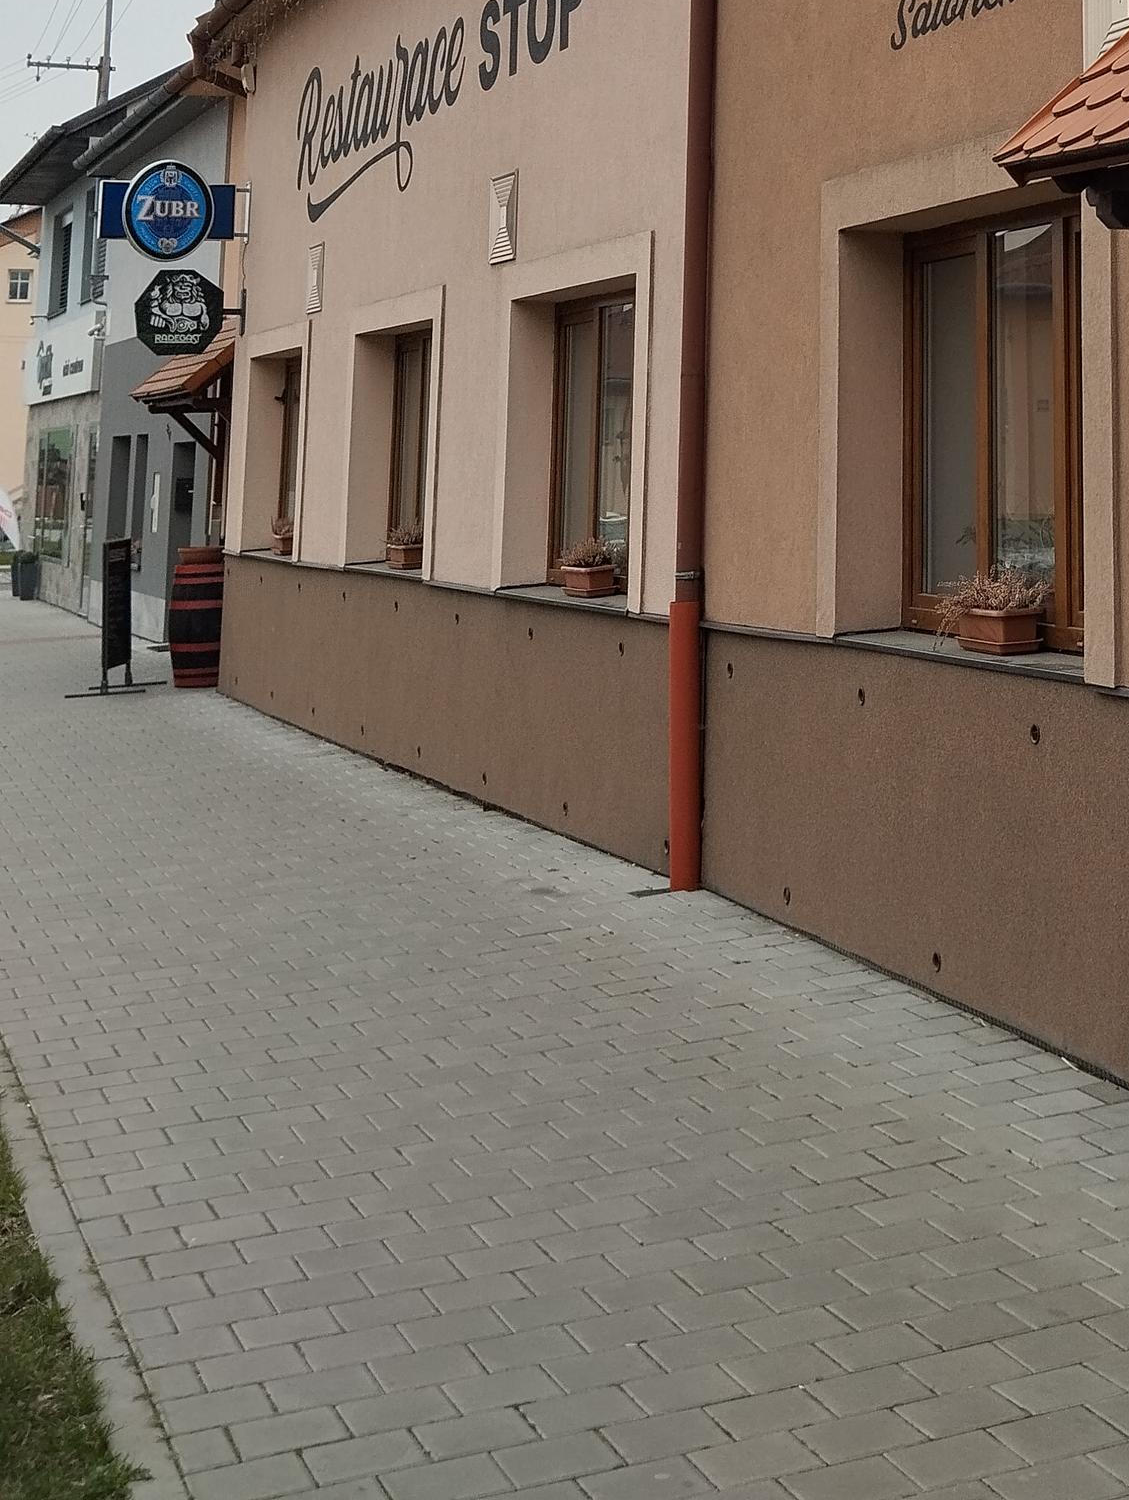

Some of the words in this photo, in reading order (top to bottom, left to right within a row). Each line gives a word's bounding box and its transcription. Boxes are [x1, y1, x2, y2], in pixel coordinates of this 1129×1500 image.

[297, 16, 467, 223] Restaurace
[136, 194, 200, 221] ZUBR
[154, 333, 202, 345] RADEGAST
